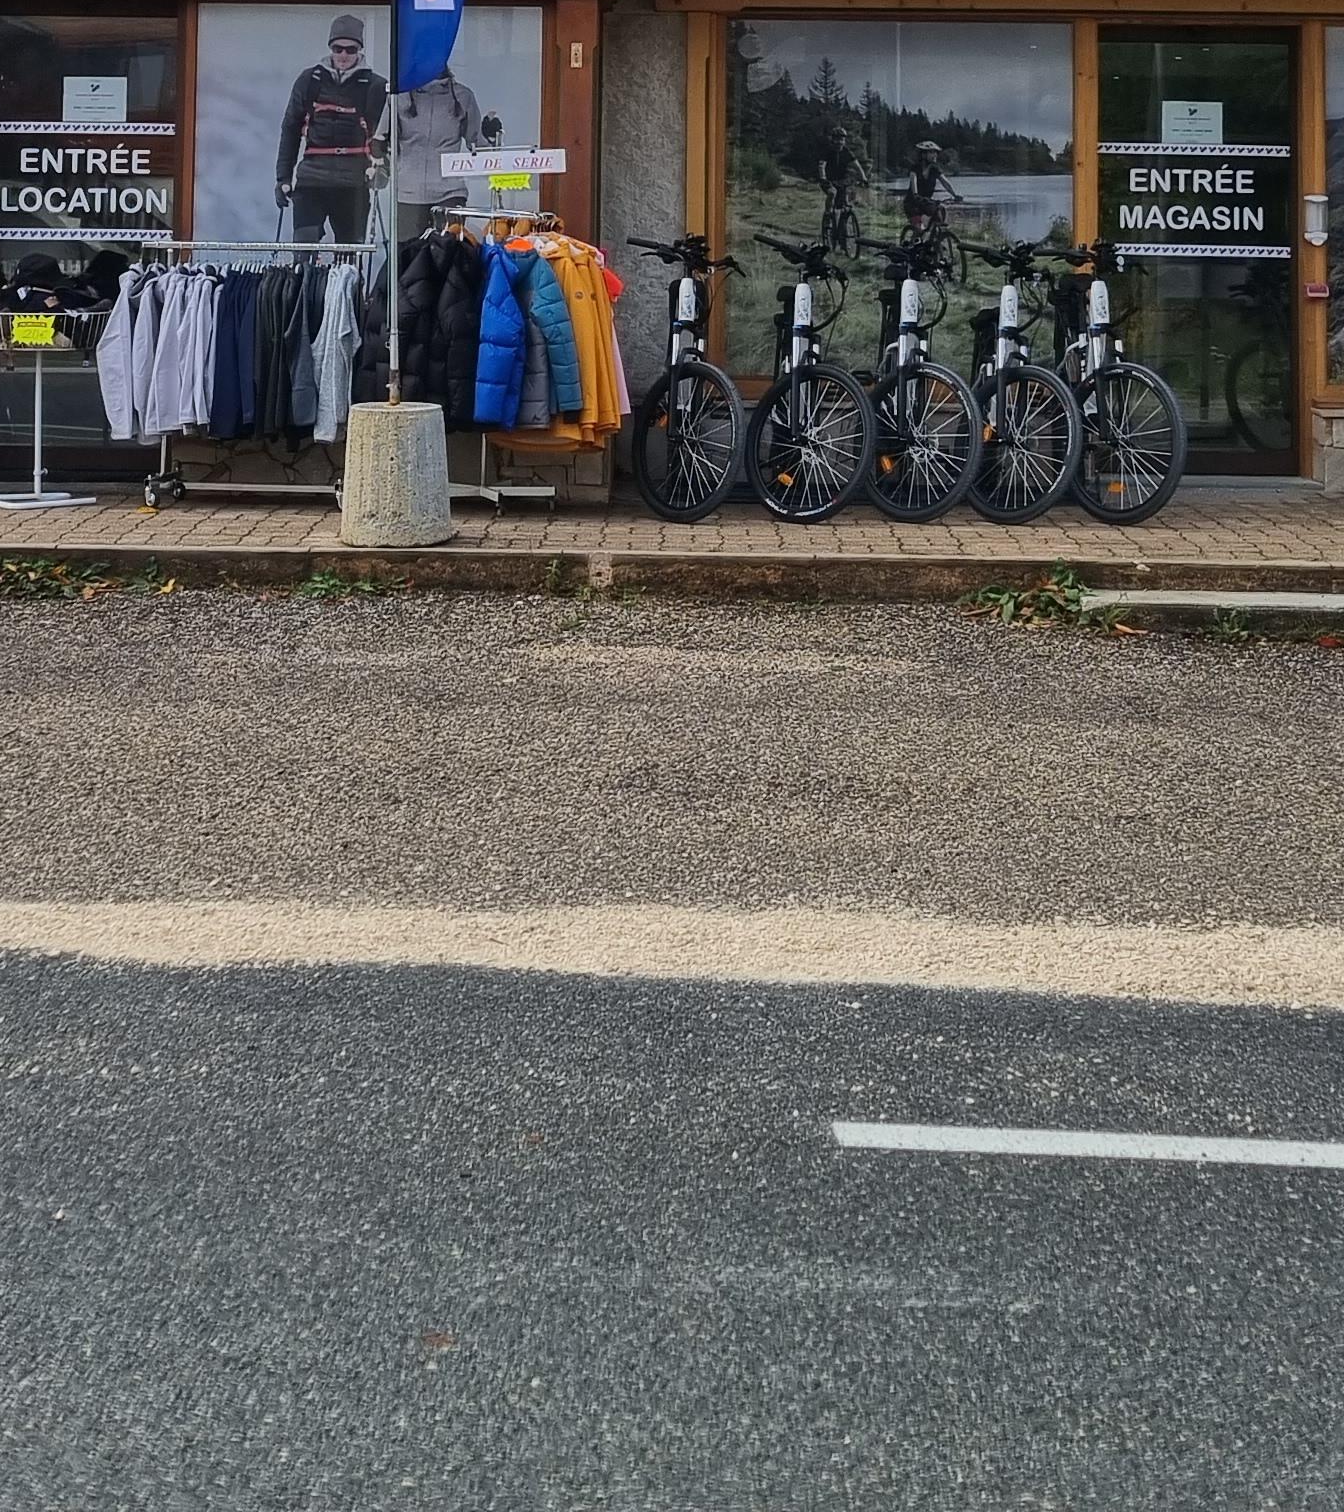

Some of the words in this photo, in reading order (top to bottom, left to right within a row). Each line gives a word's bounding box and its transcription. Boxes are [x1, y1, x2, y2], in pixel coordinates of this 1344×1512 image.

[20, 143, 151, 175] ENTRÉE
[451, 158, 473, 171] FIN
[483, 157, 503, 169] DE
[513, 156, 554, 169] SERIE
[1129, 164, 1255, 194] ENTRÉE
[0, 186, 168, 214] LOCATION
[1119, 205, 1264, 231] MAGASIN
